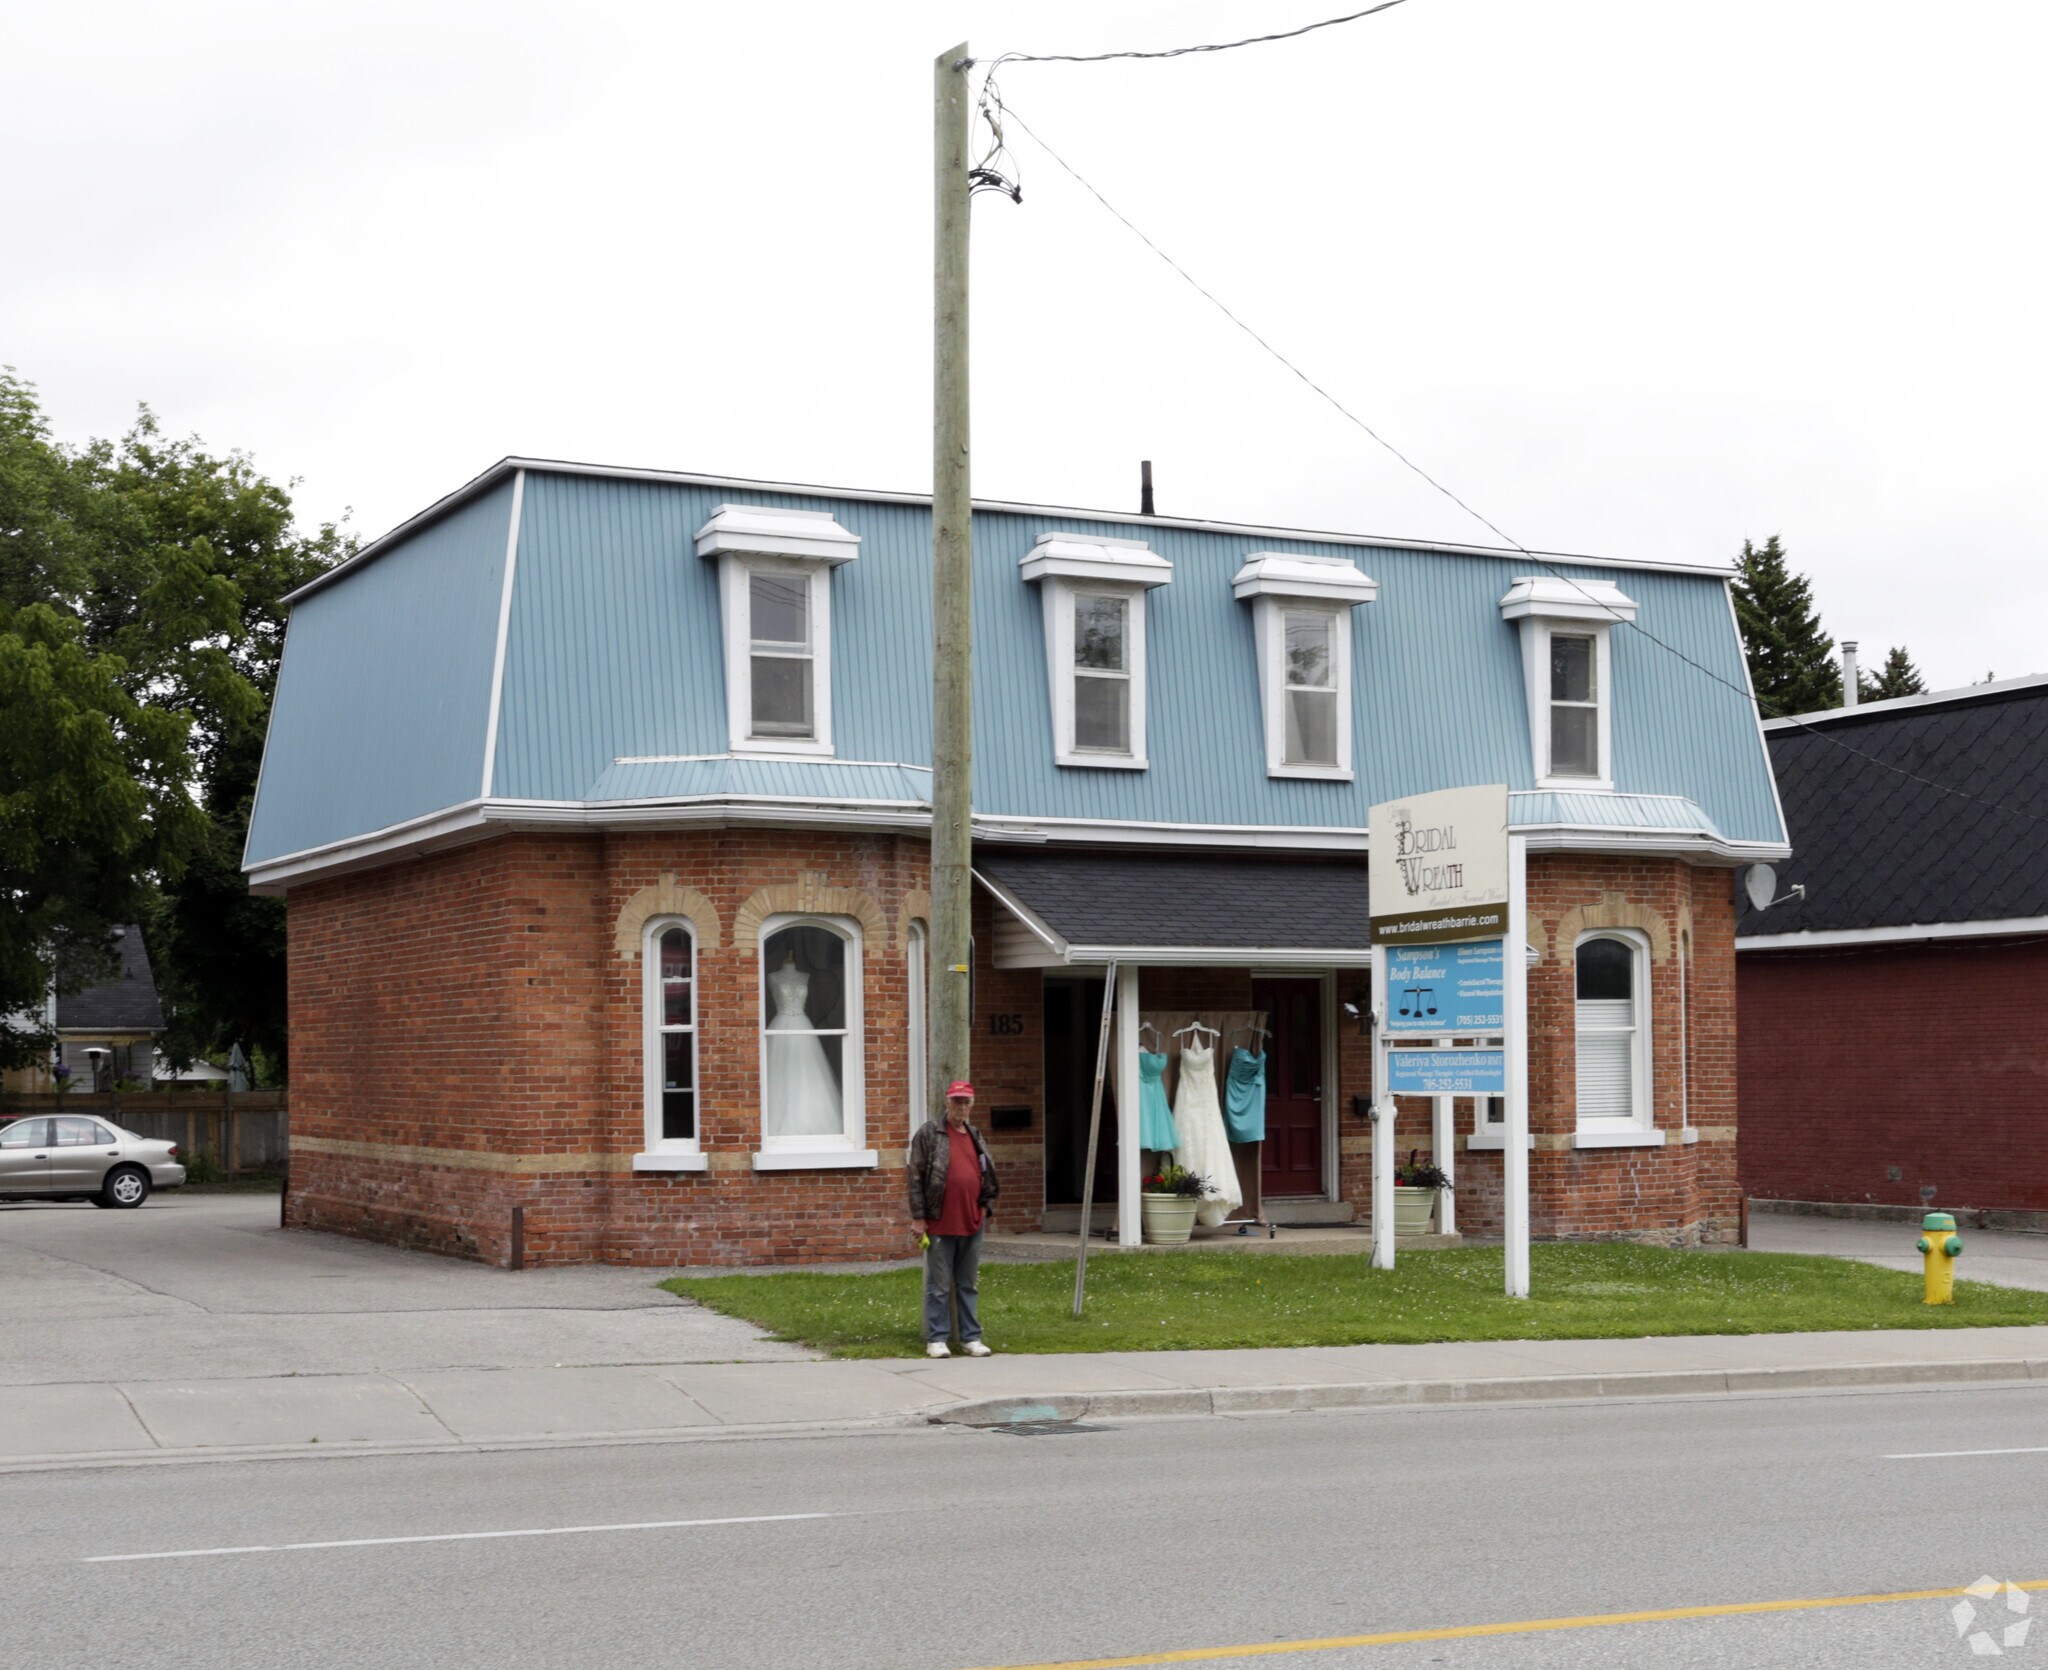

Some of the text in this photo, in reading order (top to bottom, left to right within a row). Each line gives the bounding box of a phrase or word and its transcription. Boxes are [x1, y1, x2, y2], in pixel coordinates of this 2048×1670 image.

[1398, 820, 1456, 855] BRIDAL
[1400, 856, 1463, 892] WREATH
[1379, 914, 1499, 935] www.bridalwreathbarrie.com
[1396, 947, 1441, 964] Sampson's
[1390, 966, 1446, 983] Body Balance
[988, 1014, 1024, 1036] 185
[1456, 1014, 1504, 1026] (705) 252-5531
[1394, 1053, 1502, 1070] Valeriya Storozhenko RMT
[1423, 1078, 1472, 1090] 705-252-5531
